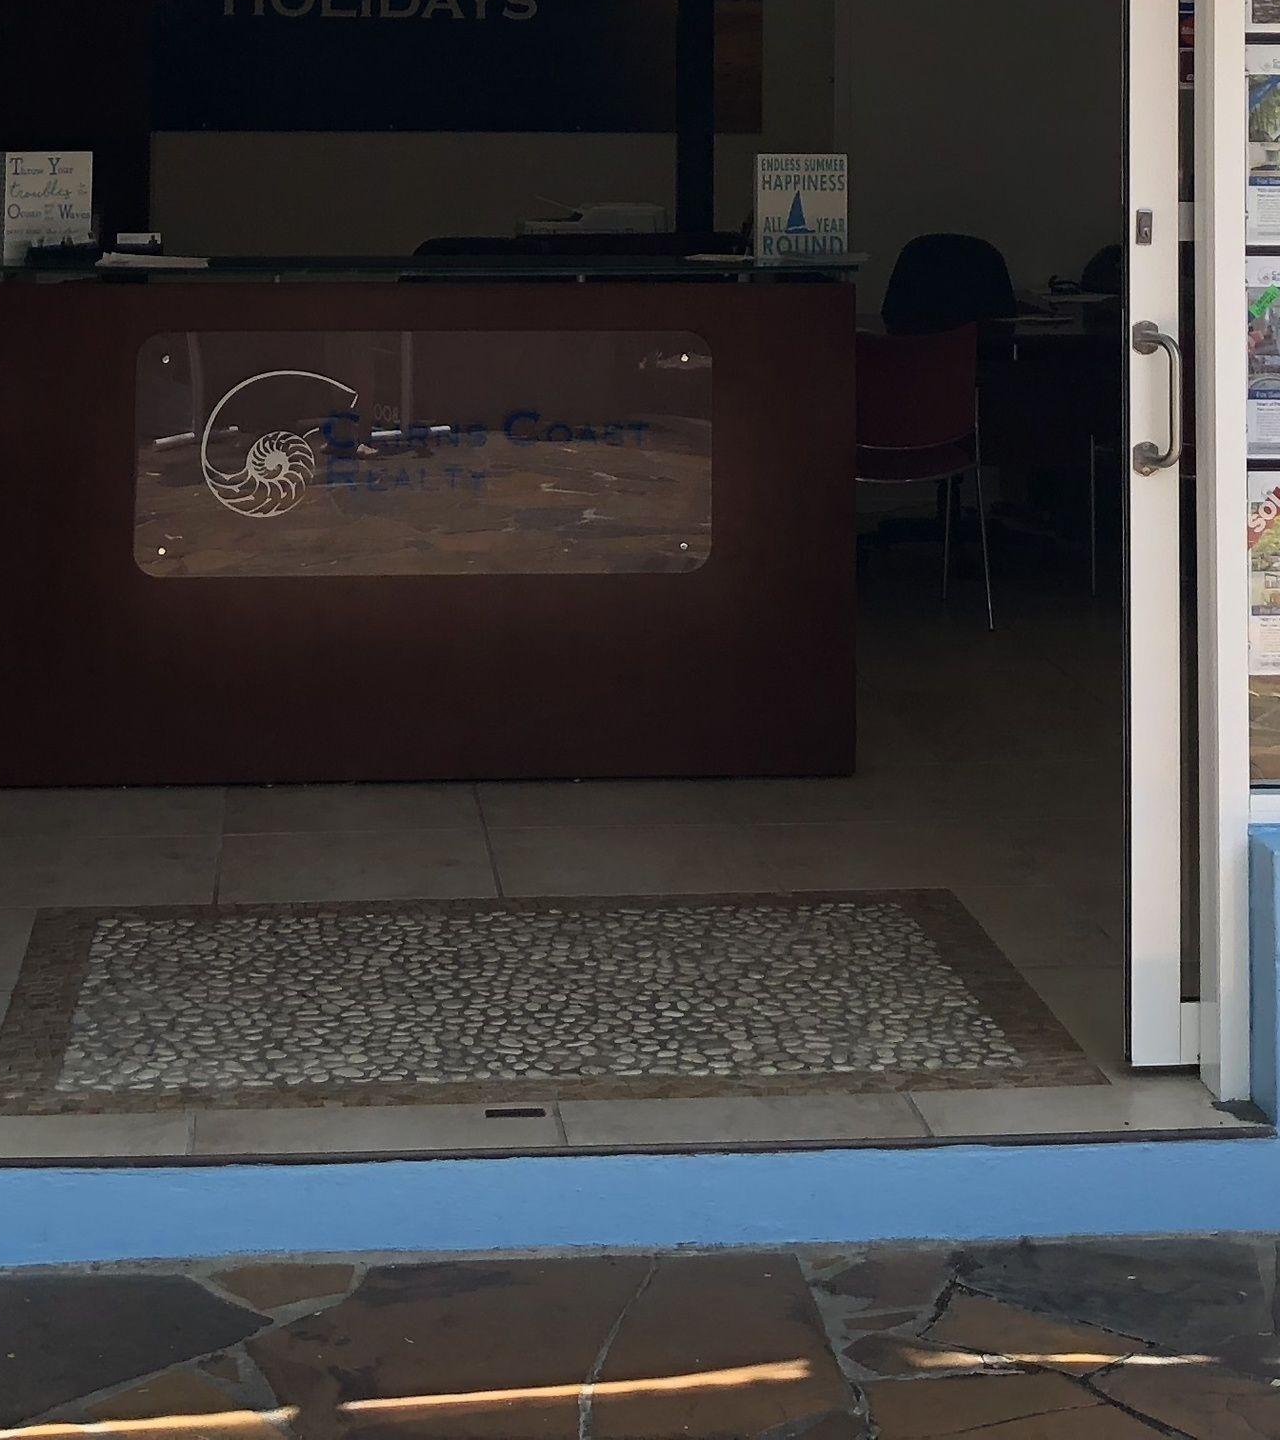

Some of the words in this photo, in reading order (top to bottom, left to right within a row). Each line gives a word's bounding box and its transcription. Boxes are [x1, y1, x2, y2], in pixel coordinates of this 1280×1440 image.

[761, 157, 801, 172] ENDLESS
[804, 158, 845, 172] SUMMER
[762, 173, 845, 192] HAPPINESS
[763, 216, 783, 233] ALL
[816, 216, 845, 233] YEAR
[762, 235, 844, 257] ROUND
[503, 410, 653, 448] COAST
[326, 454, 486, 492] REALTY
